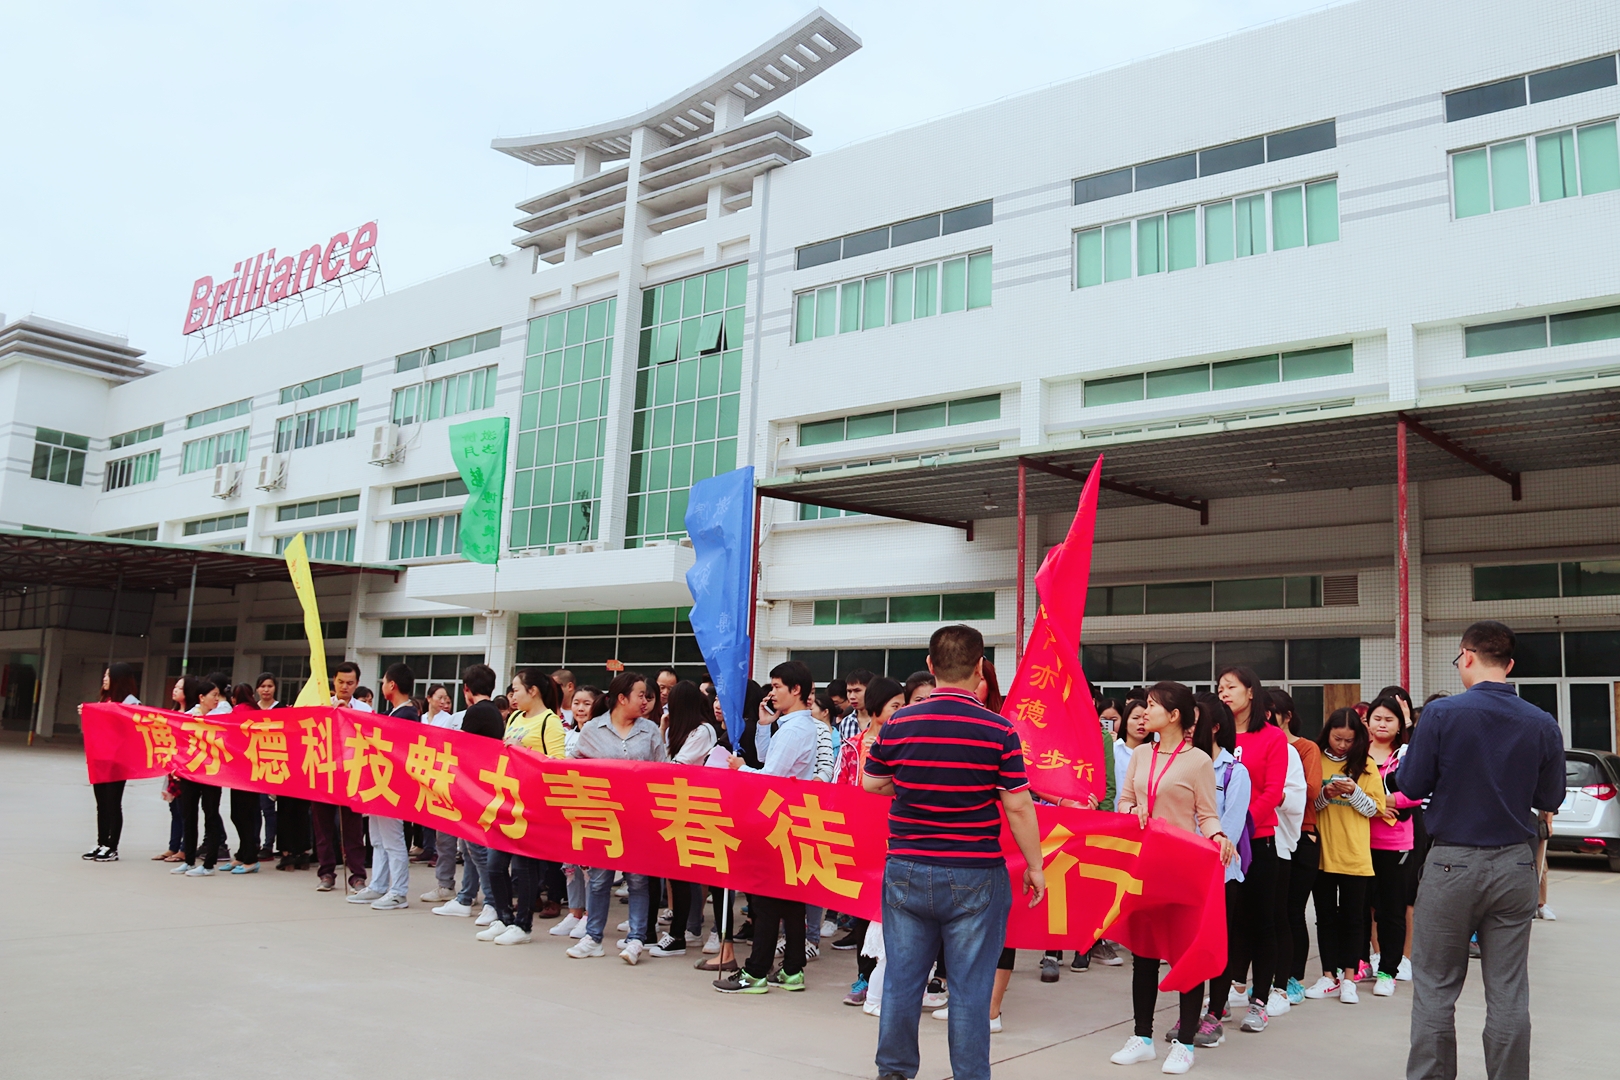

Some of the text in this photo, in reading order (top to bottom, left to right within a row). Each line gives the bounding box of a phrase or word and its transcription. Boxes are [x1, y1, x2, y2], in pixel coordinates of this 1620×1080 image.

[183, 221, 378, 335] Brilliance
[132, 712, 1143, 940] 博亦德科技魅力青春徒行
